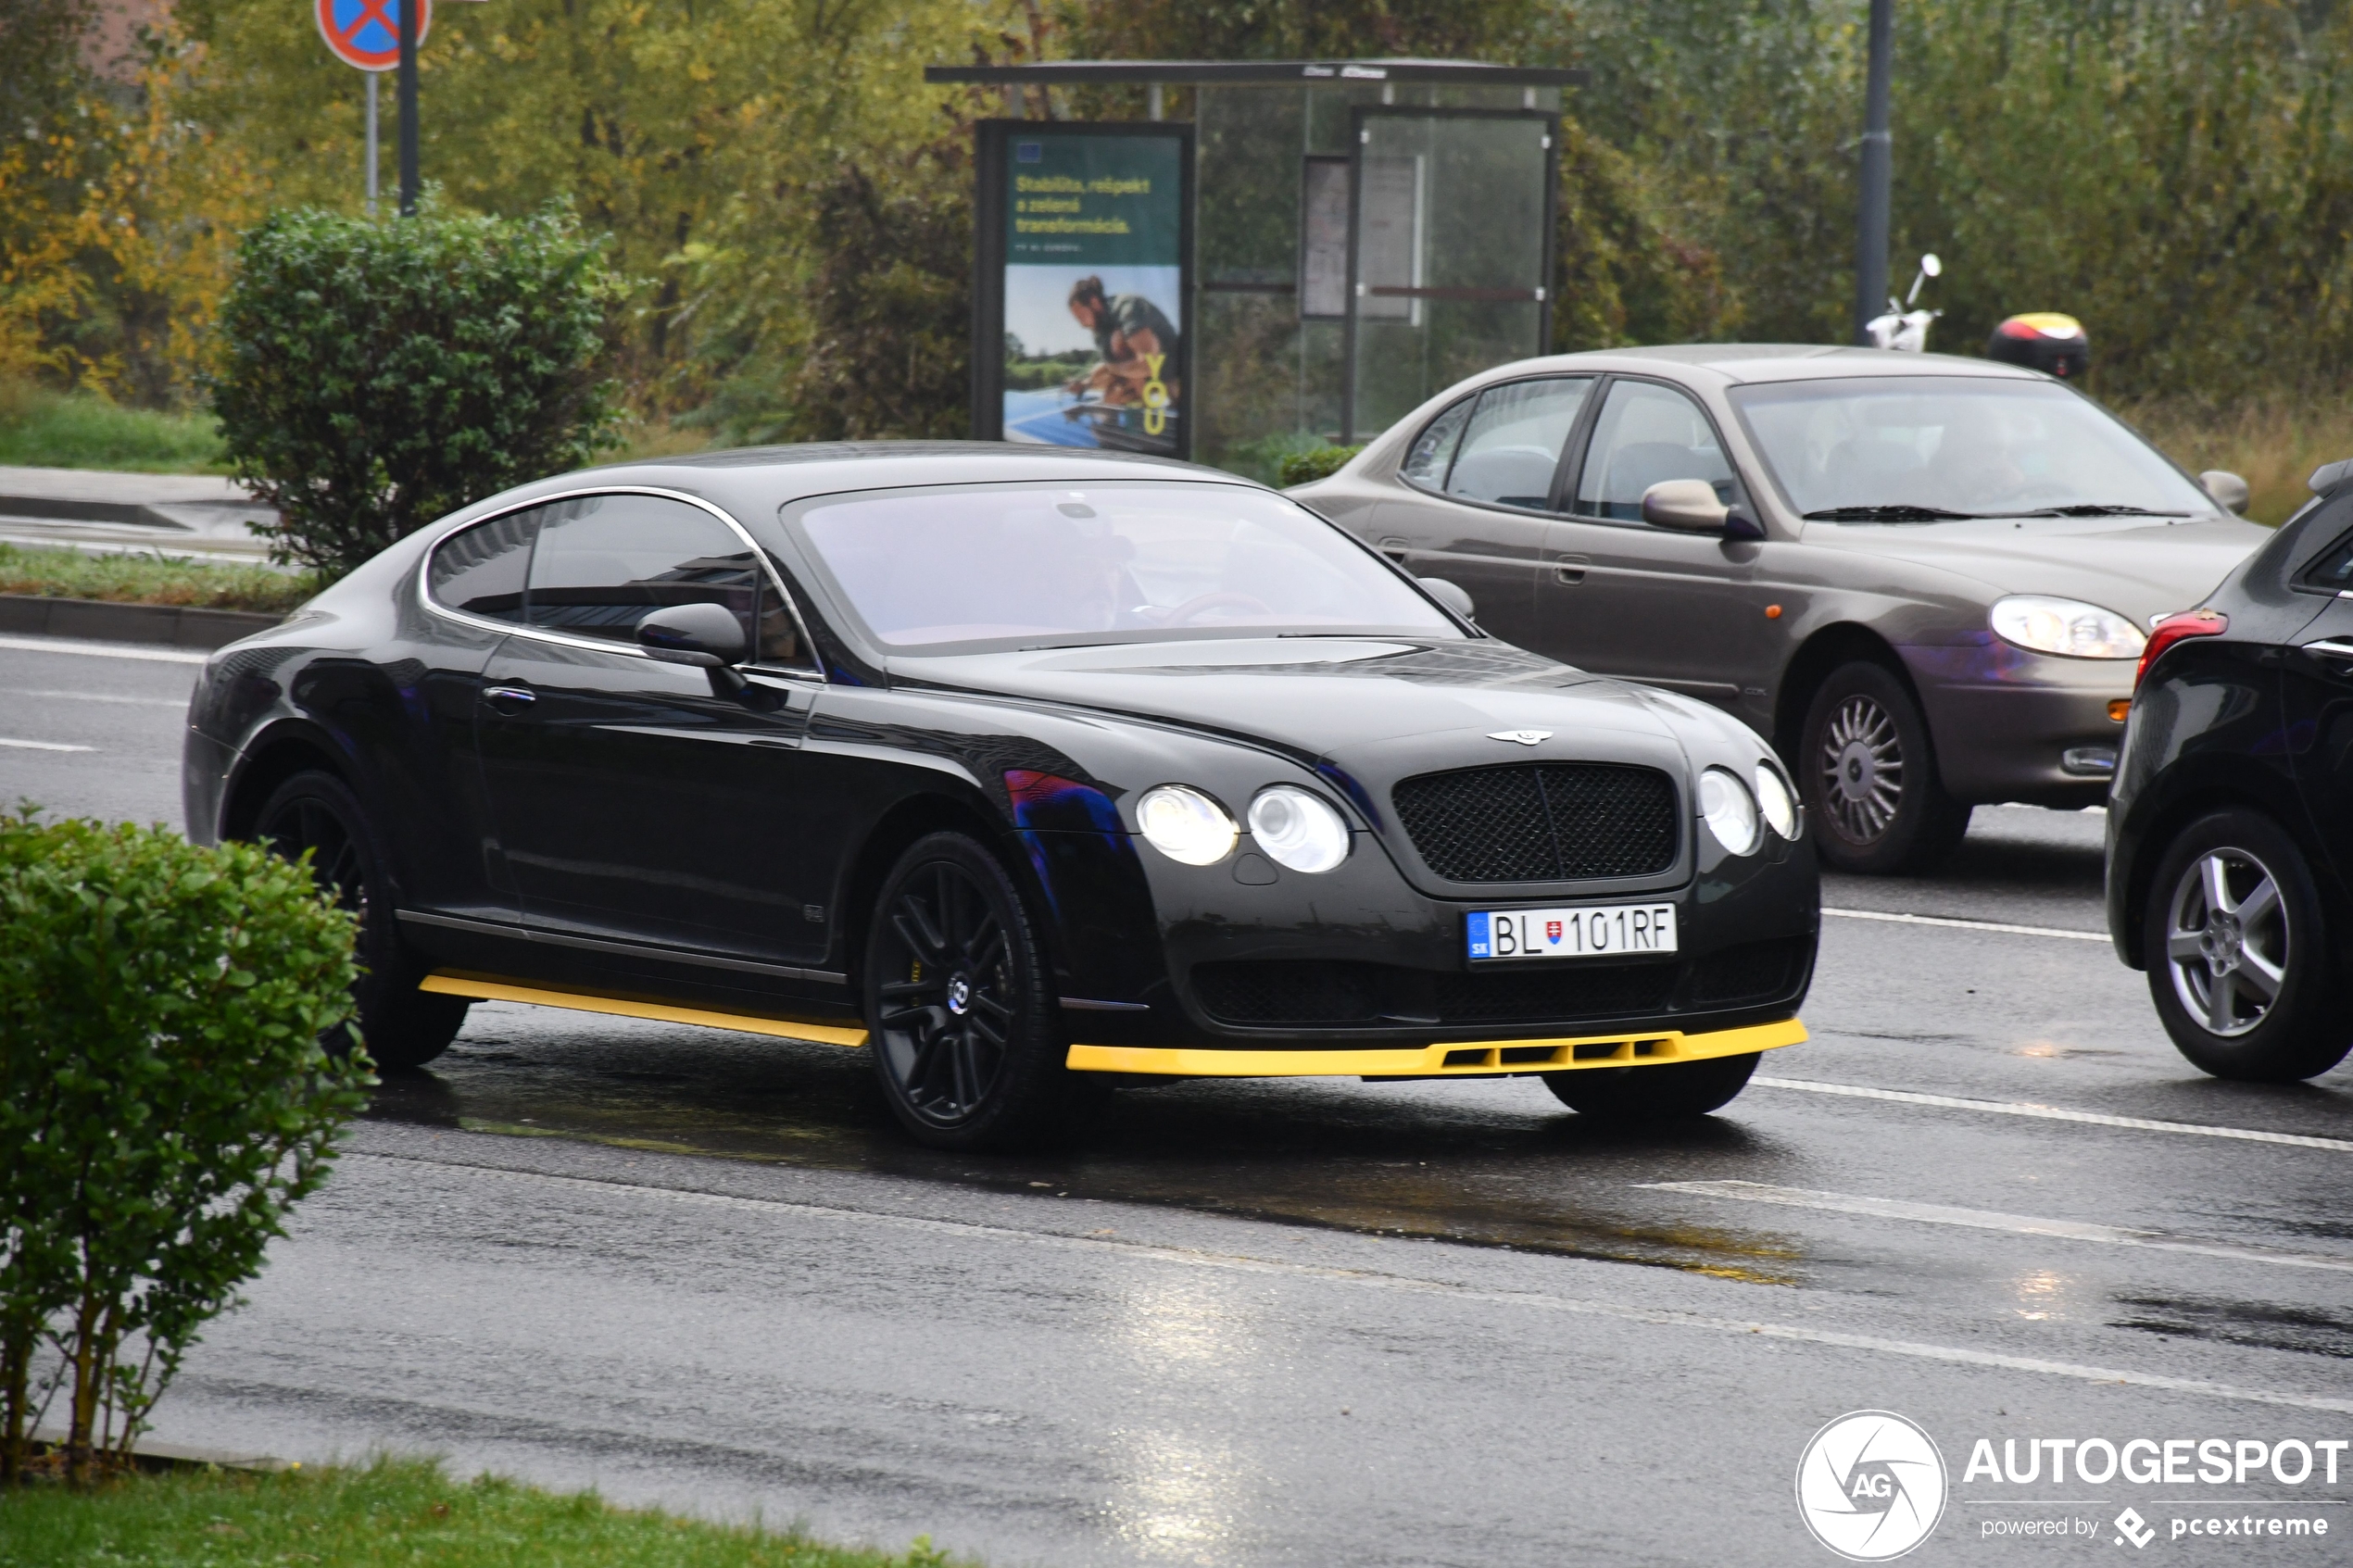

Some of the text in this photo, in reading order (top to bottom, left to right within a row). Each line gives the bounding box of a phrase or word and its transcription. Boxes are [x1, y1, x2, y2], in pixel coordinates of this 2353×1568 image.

[1142, 353, 1167, 434] YOU
[1472, 943, 1489, 955] SK
[1495, 909, 1669, 956] BL 101RF
